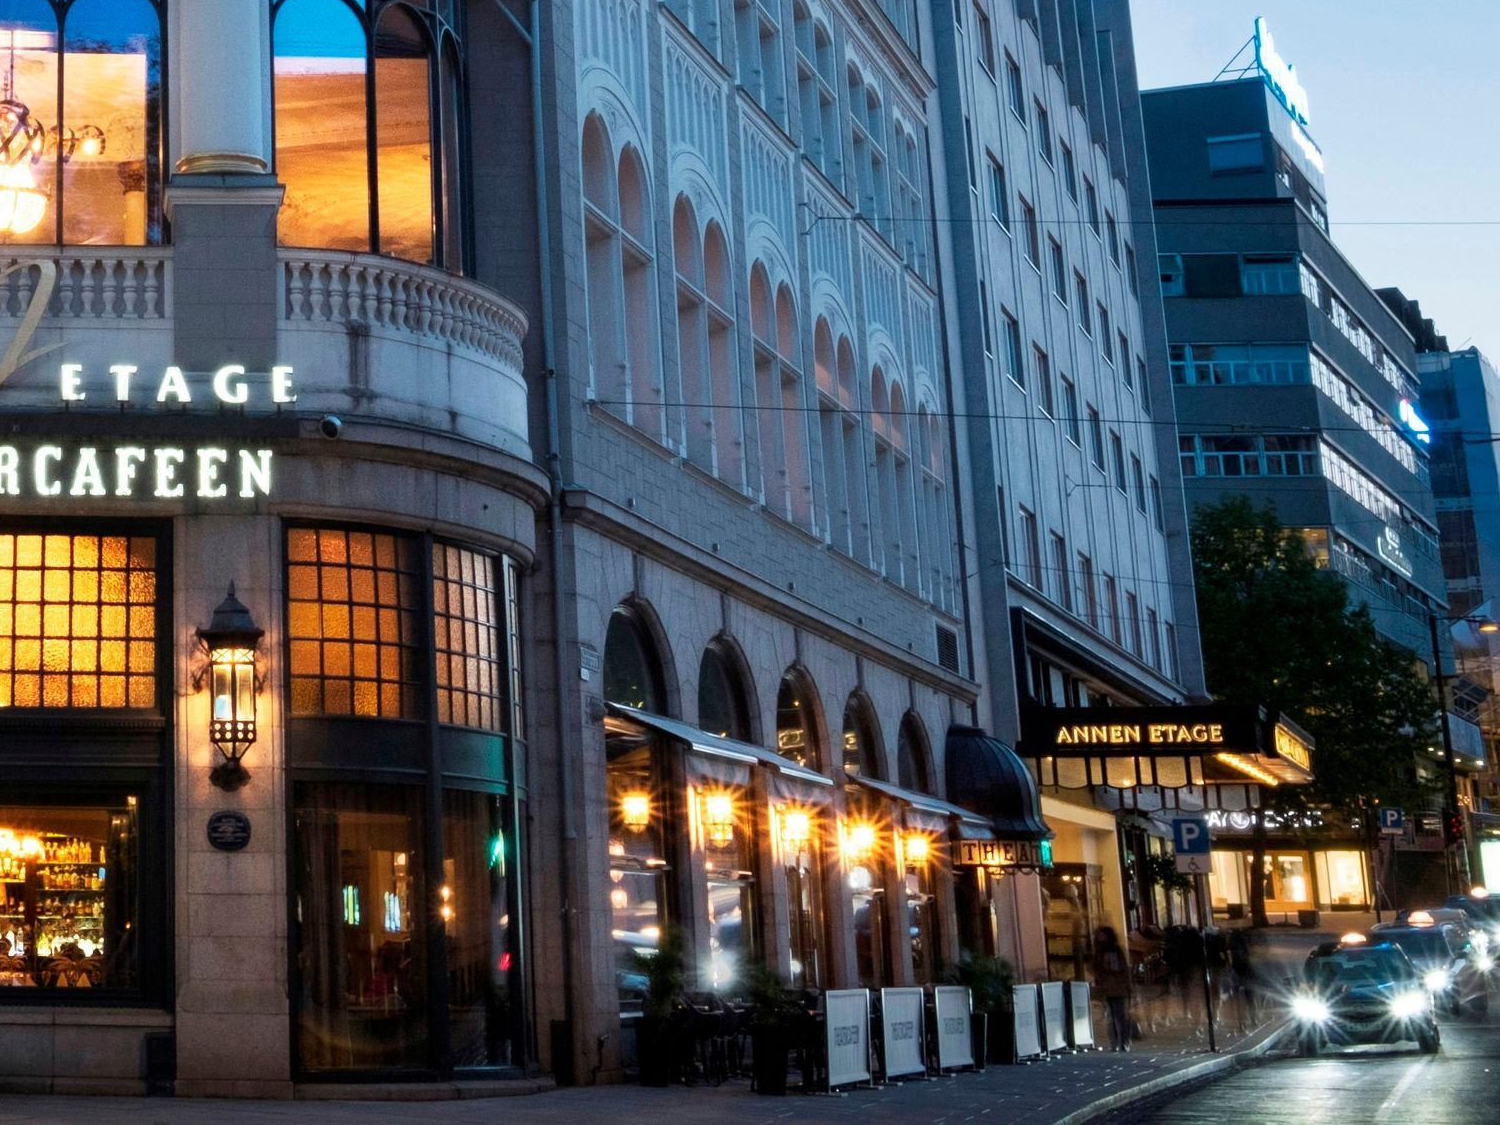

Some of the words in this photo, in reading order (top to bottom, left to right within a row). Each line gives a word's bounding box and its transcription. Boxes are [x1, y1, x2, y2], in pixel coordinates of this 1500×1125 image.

[60, 363, 298, 404] ETAGE
[1056, 725, 1141, 744] ANNEN
[1148, 724, 1224, 743] ETAGE
[1387, 810, 1398, 826] P
[1180, 823, 1200, 850] P
